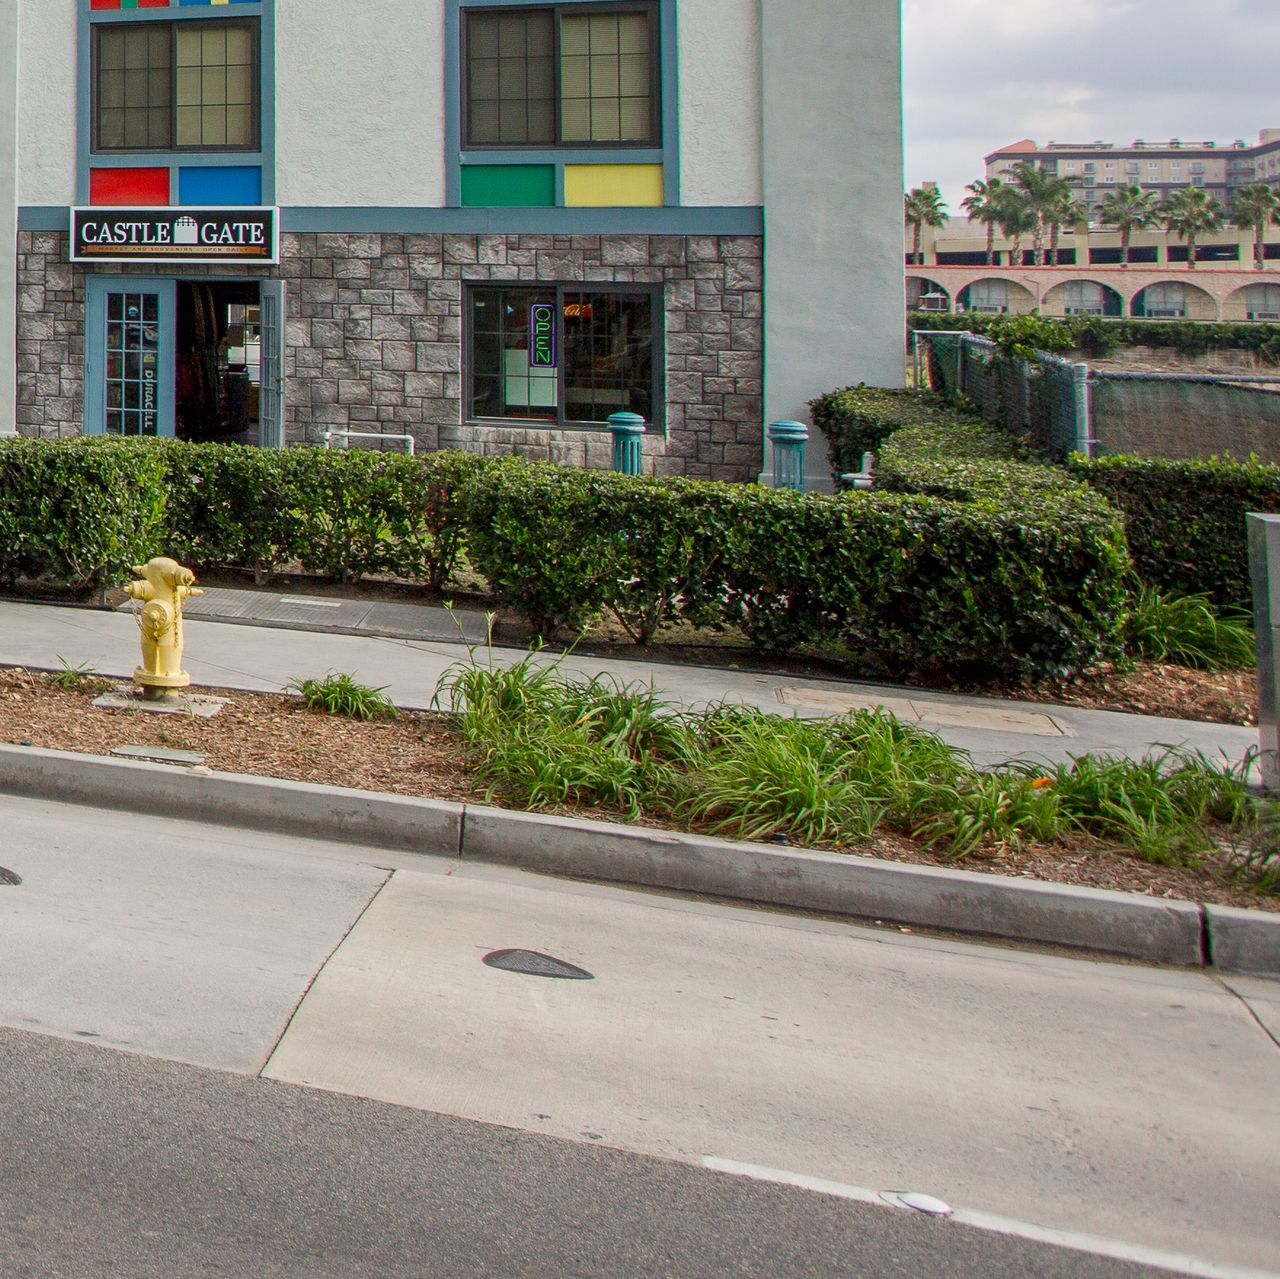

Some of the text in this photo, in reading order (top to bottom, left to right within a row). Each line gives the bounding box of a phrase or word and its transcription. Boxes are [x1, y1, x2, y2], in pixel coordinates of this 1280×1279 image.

[81, 222, 264, 244] CASTLE GATE
[535, 308, 551, 363] OPEN
